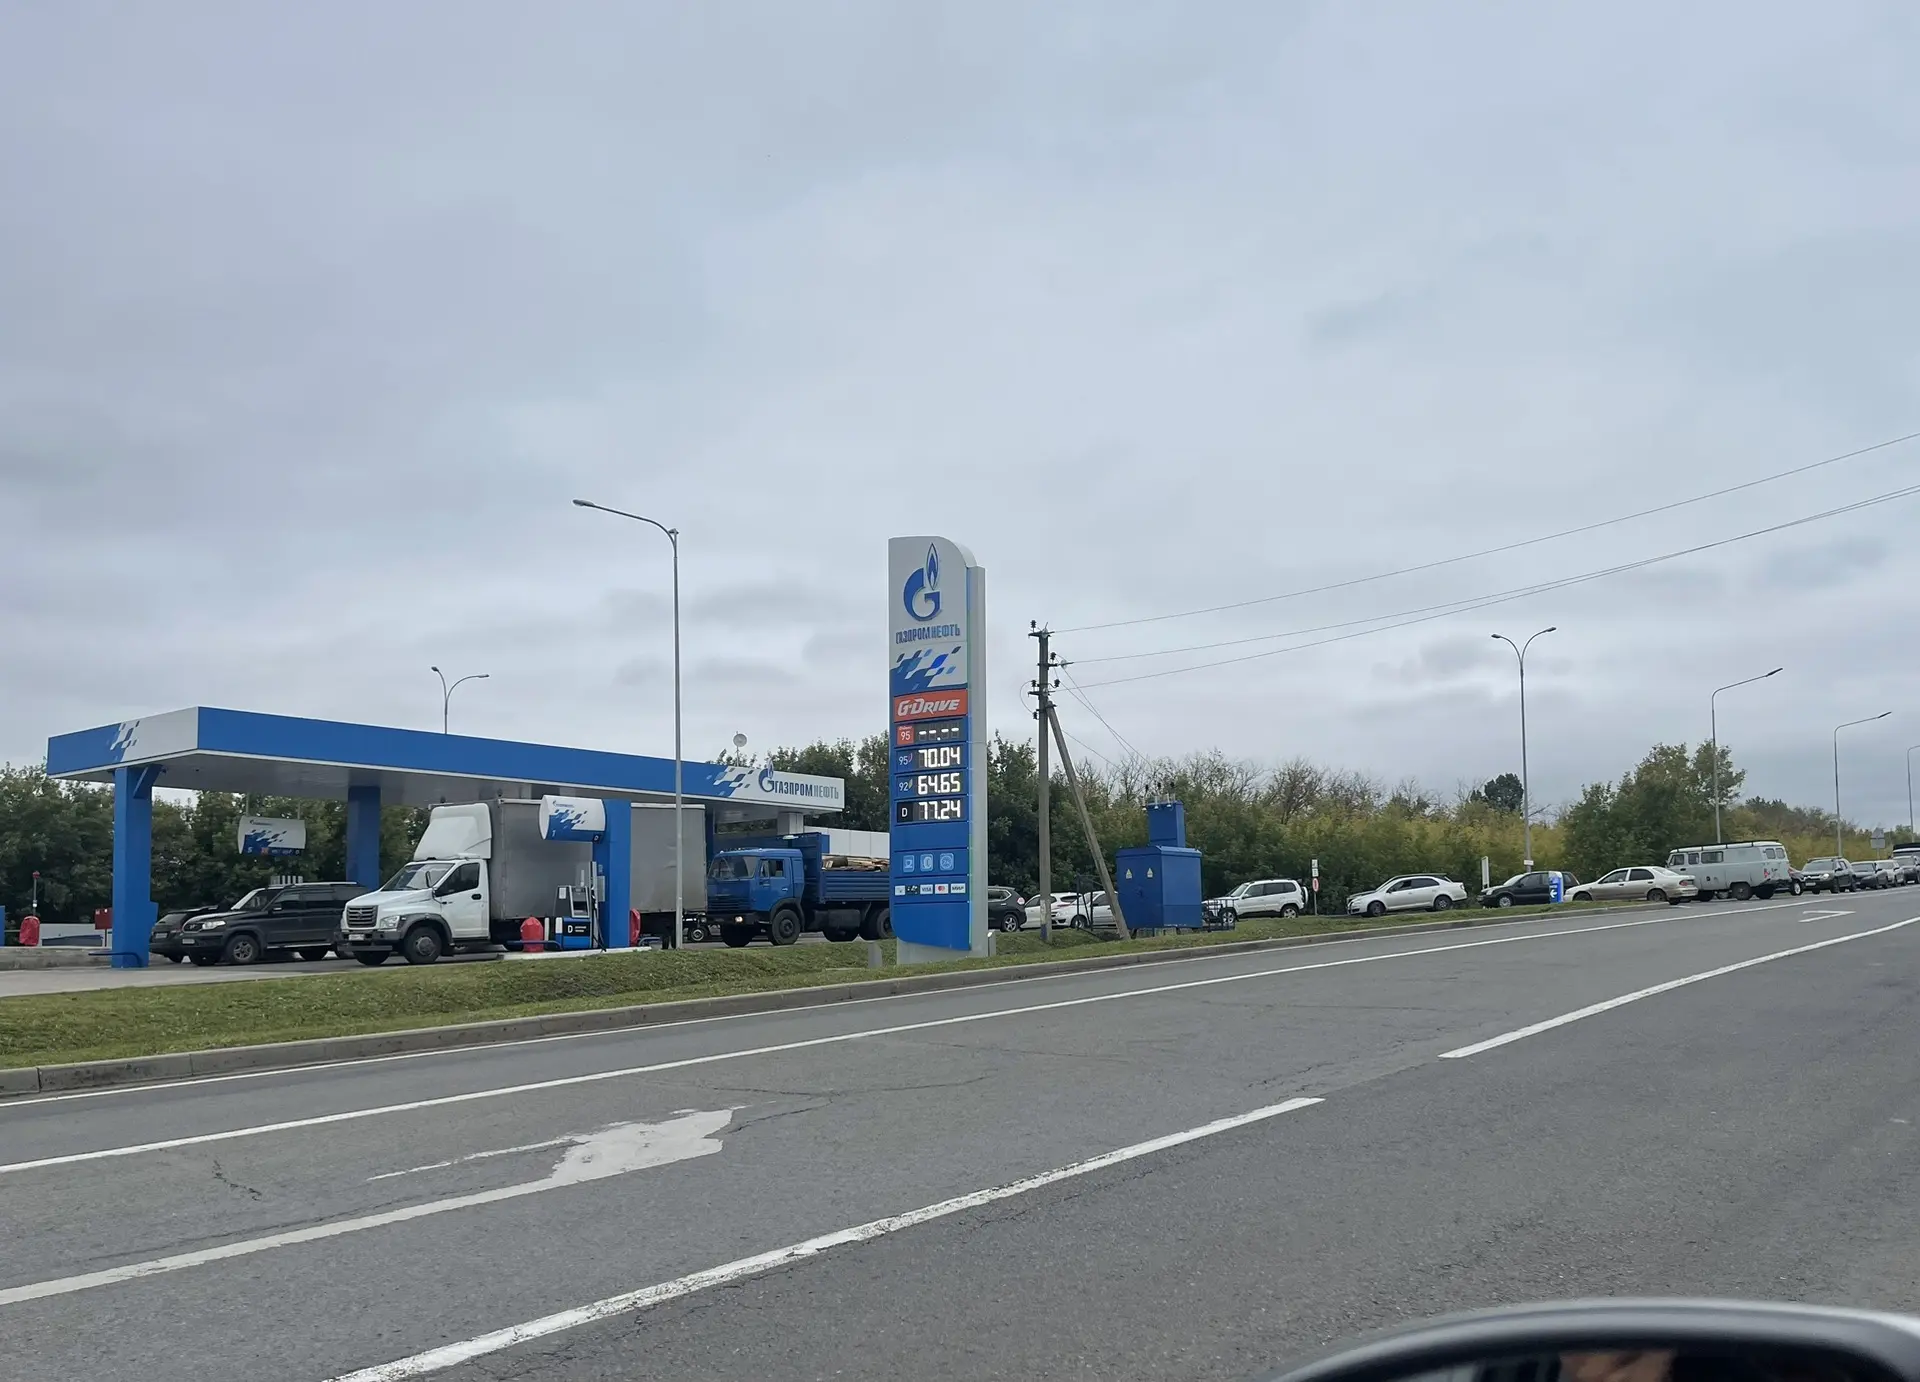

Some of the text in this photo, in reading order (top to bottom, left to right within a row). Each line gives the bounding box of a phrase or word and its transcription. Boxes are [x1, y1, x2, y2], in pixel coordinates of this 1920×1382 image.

[895, 623, 960, 645] ГАЗПРОМНЕФТЬ
[900, 730, 911, 741] 95
[898, 746, 961, 768] 95 70.04
[774, 780, 840, 800] ГАЗПРОМНЕФТЬ
[898, 772, 961, 795] 92 64.65
[901, 799, 961, 820] D 77.24
[567, 924, 574, 934] D
